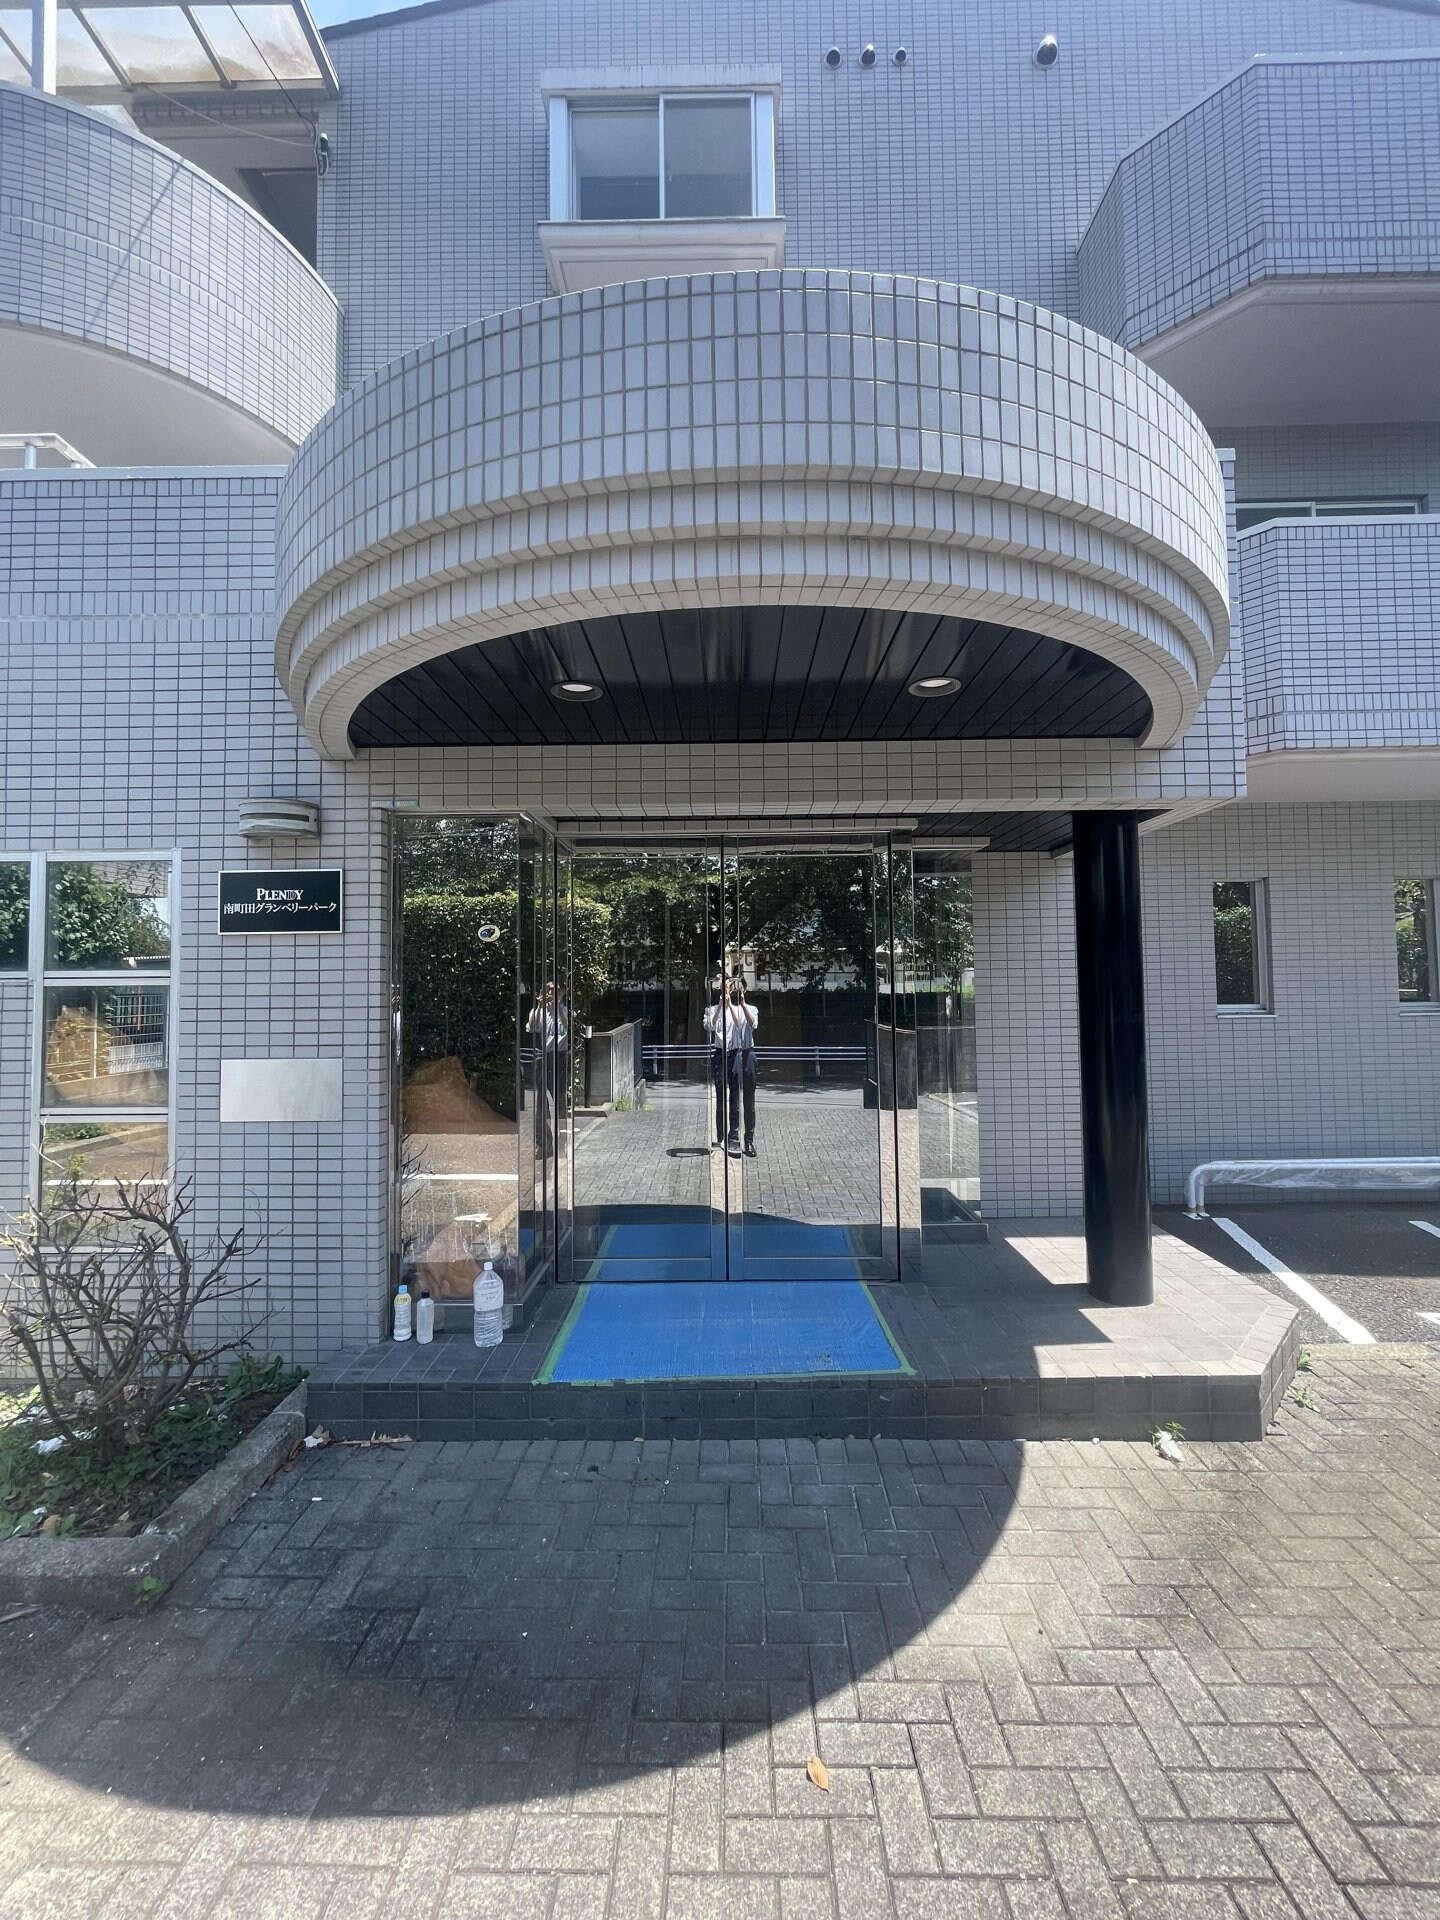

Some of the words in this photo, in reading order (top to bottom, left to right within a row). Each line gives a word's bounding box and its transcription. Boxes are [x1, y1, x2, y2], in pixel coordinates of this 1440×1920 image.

[223, 902, 337, 915] 南町田グランベリーパーク
